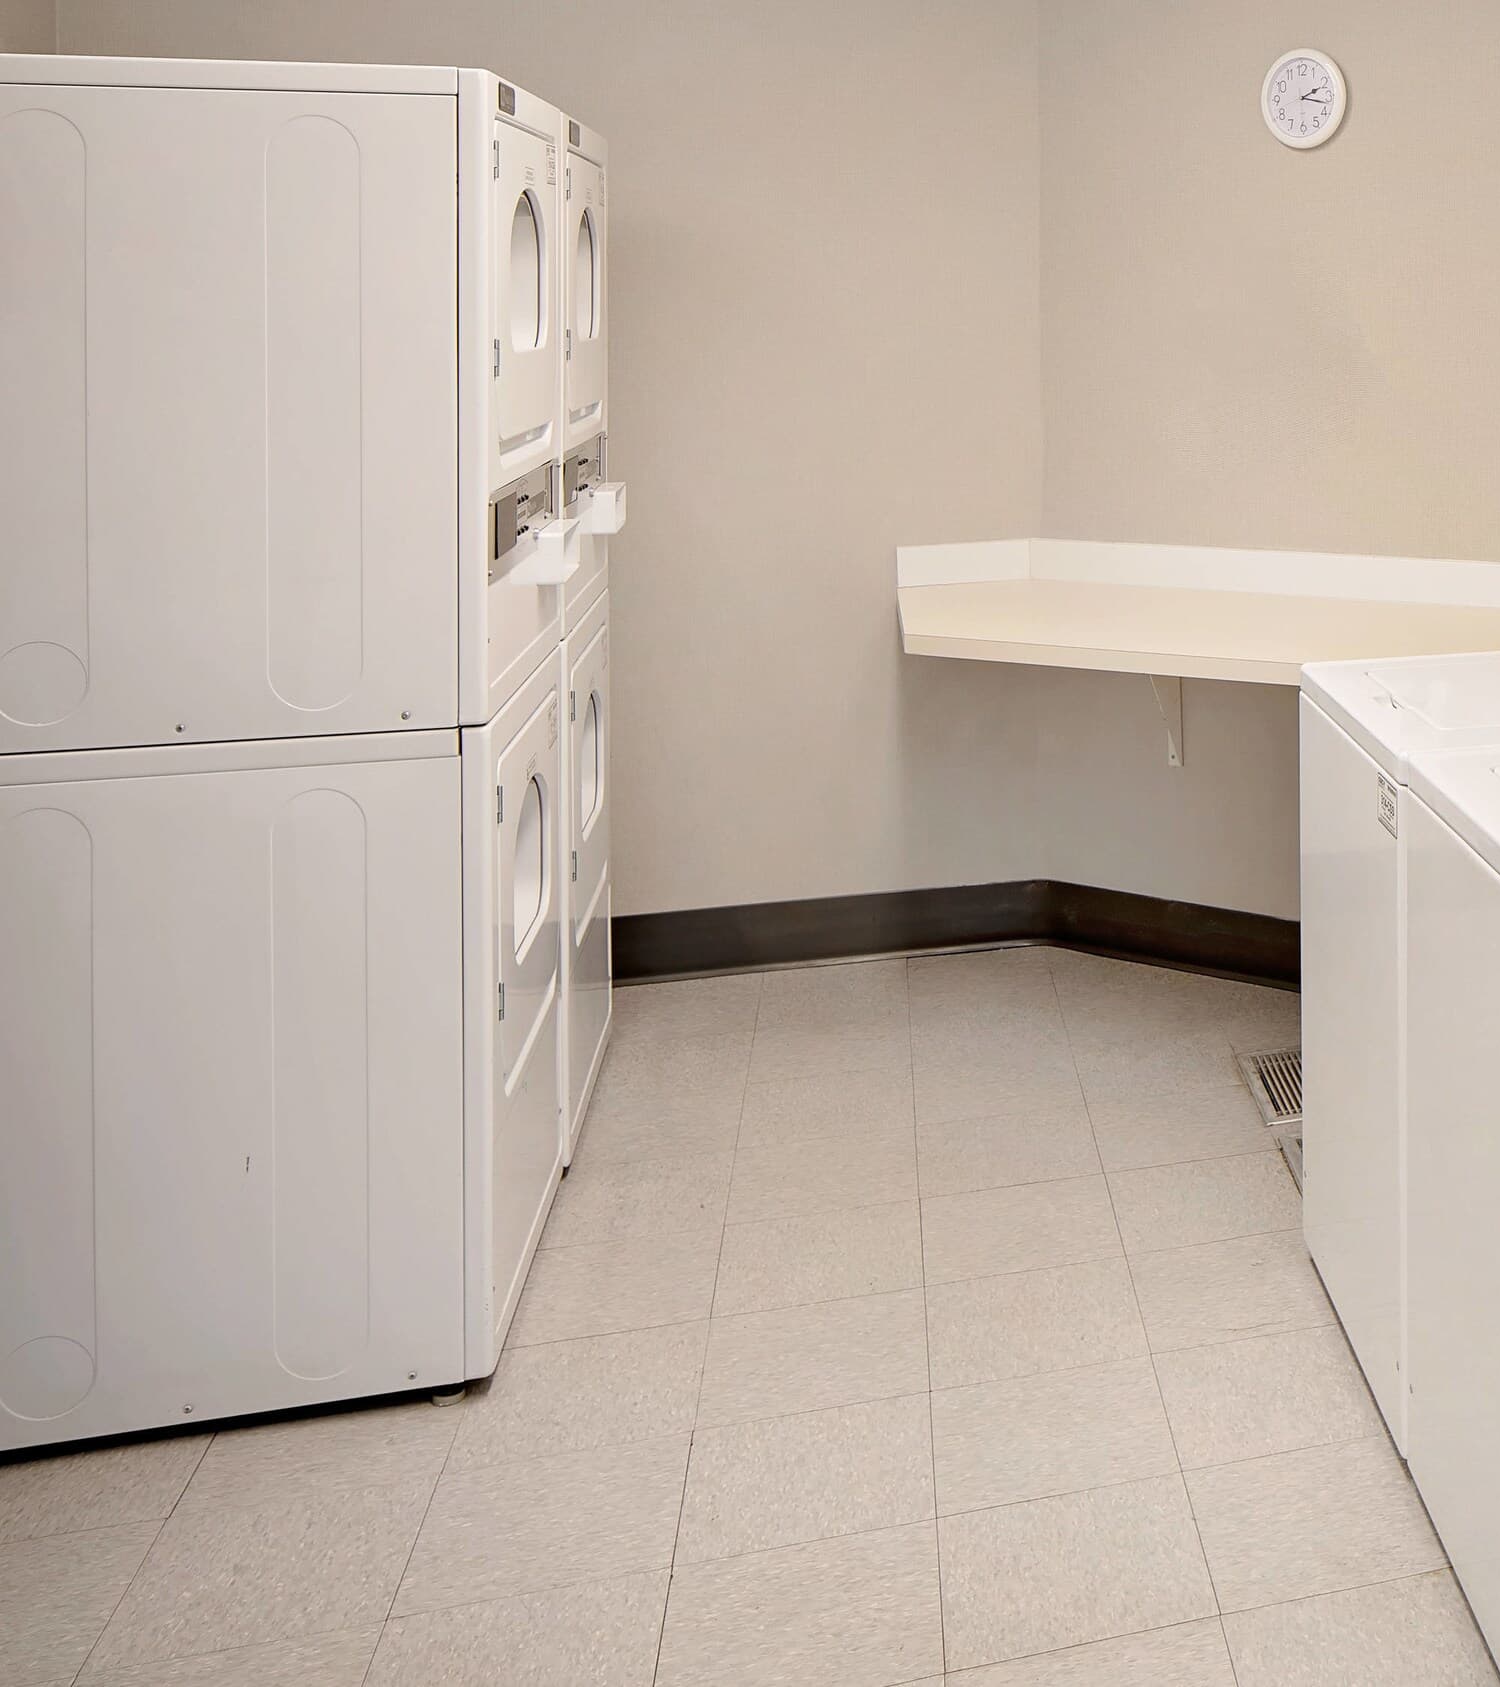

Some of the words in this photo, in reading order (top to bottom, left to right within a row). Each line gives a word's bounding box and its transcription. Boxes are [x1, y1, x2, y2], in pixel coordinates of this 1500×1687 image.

[1287, 69, 1293, 80] 11
[1297, 64, 1308, 76] 12
[1320, 77, 1328, 88] 2
[1274, 95, 1280, 106] 9
[1325, 90, 1332, 103] 3
[1279, 108, 1285, 120] 8
[1320, 106, 1327, 117] 4
[1288, 119, 1294, 129] 7
[1300, 121, 1307, 133] 6
[1312, 116, 1320, 128] 5
